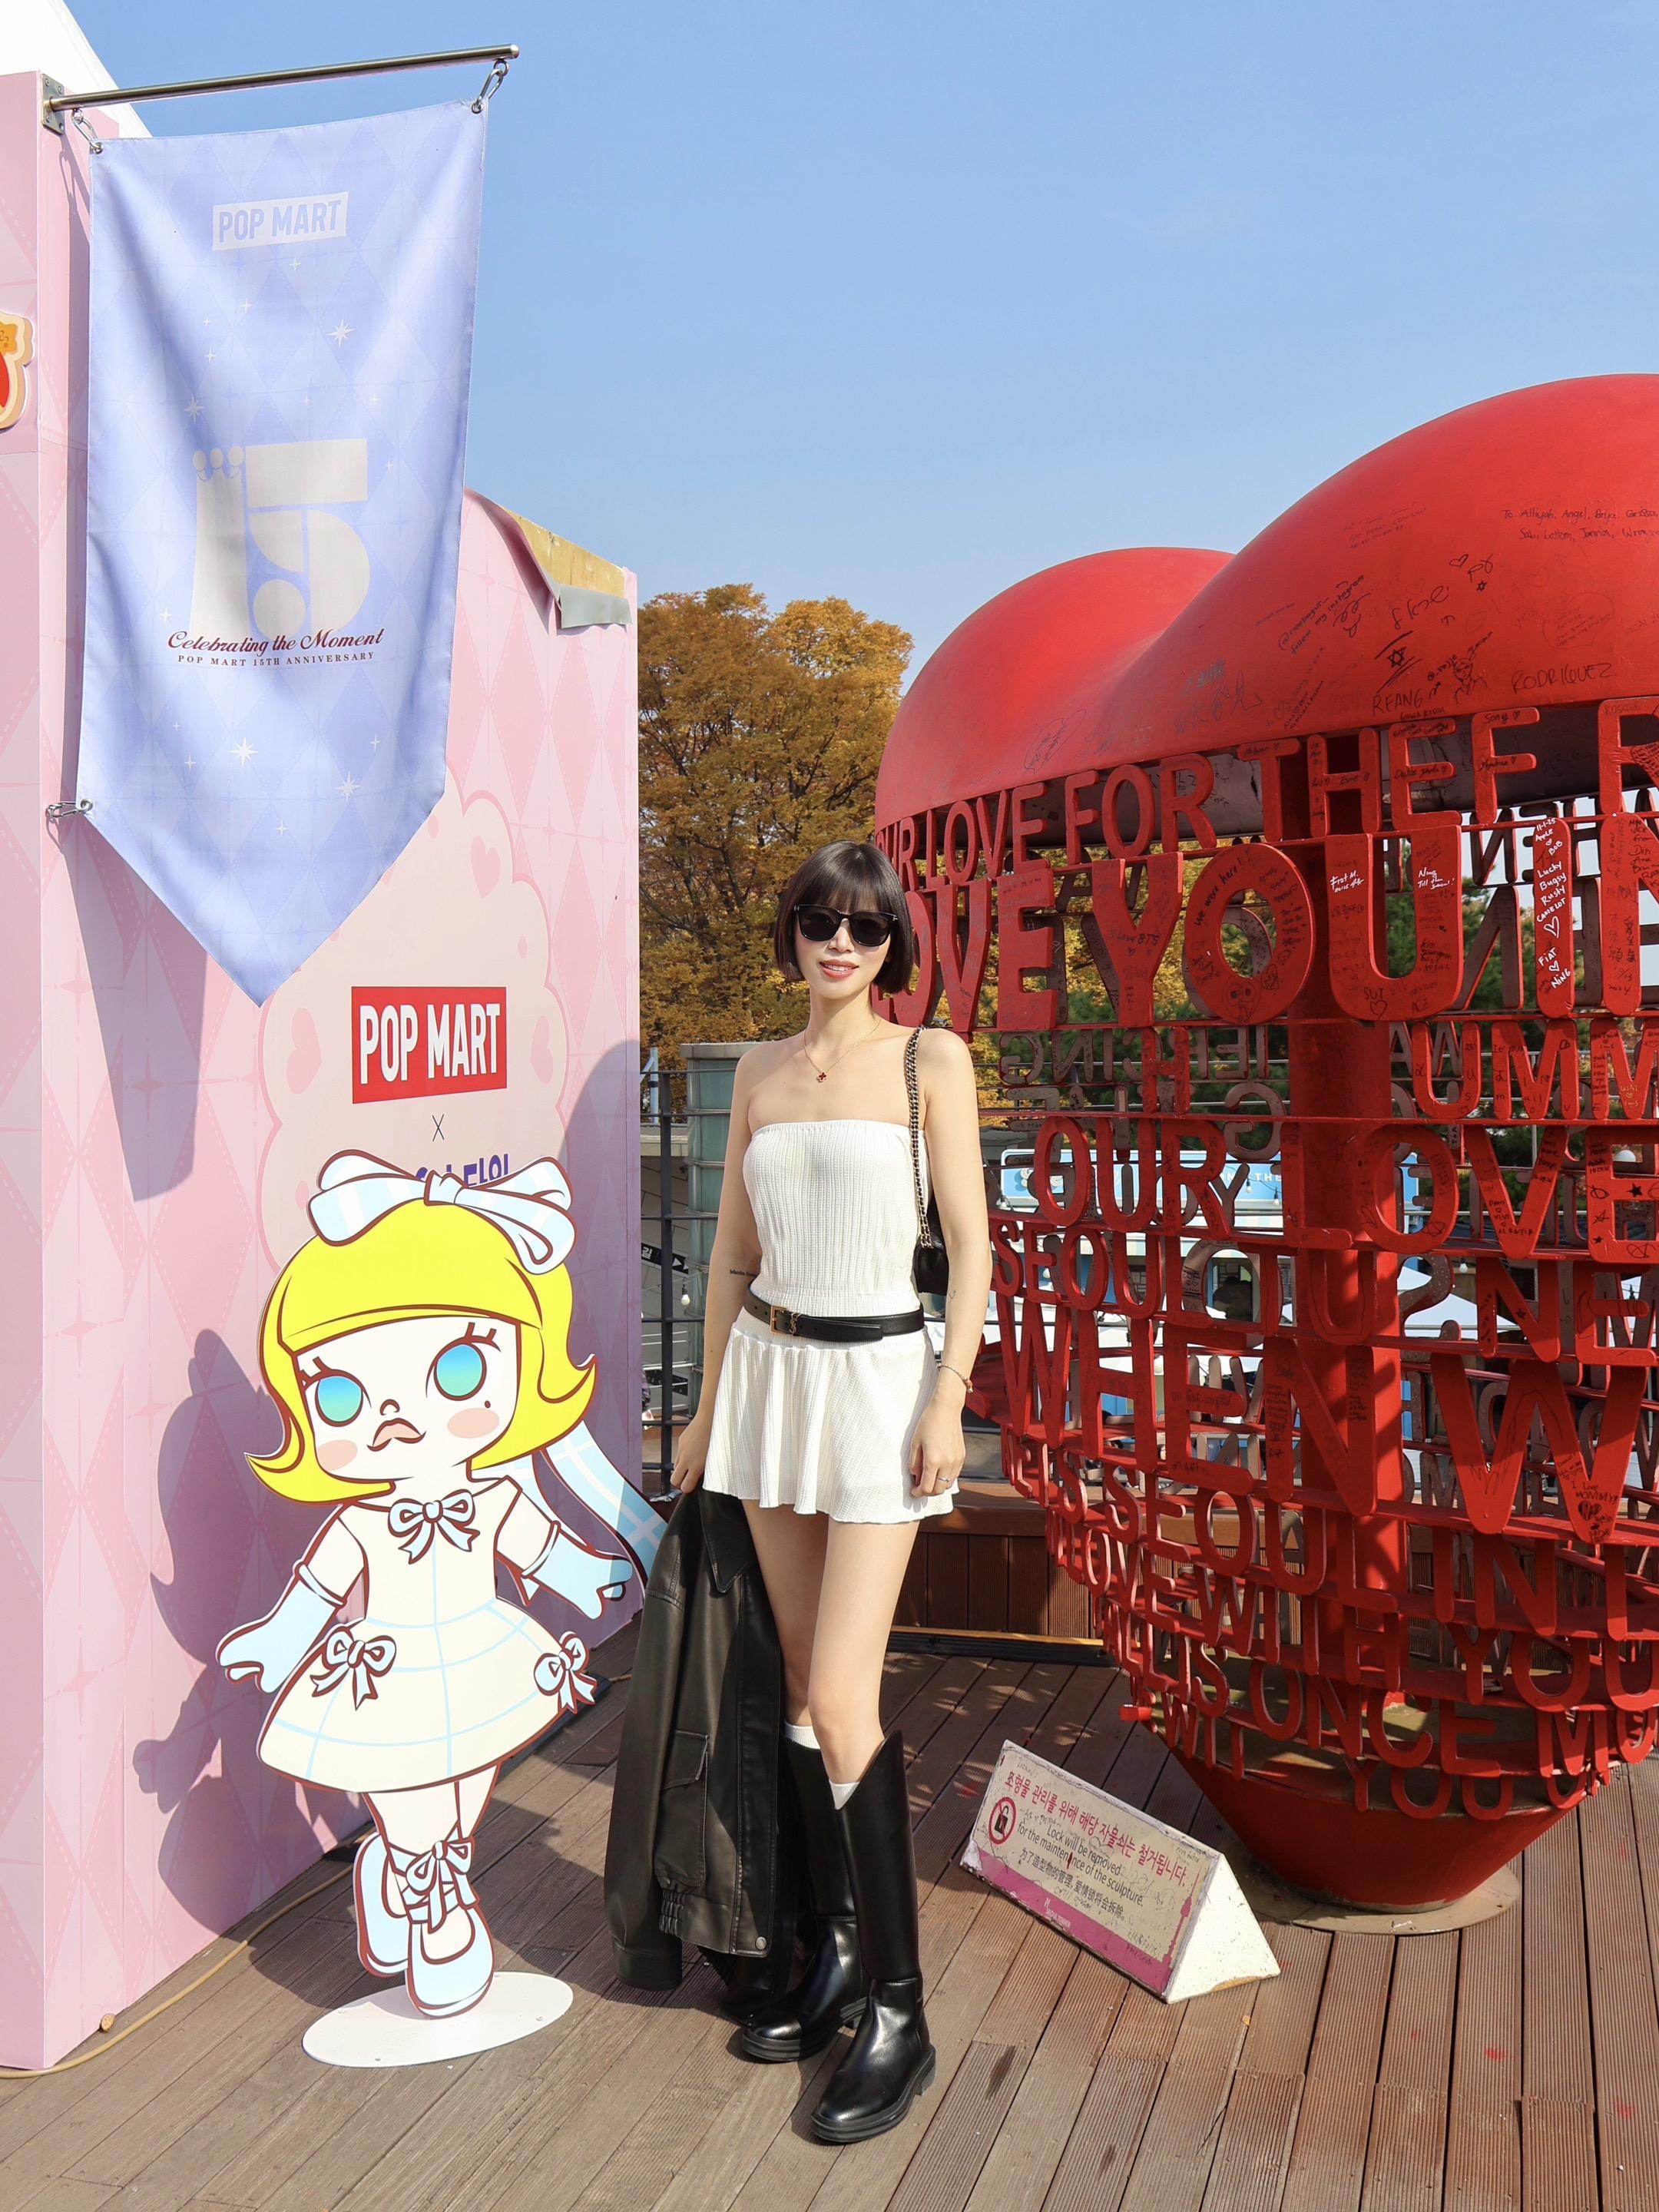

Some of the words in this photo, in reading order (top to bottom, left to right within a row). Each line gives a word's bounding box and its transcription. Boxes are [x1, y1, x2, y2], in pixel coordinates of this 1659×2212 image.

[219, 208, 265, 243] POP
[271, 200, 342, 237] MART
[168, 630, 269, 657] Celebrating
[272, 634, 296, 652] the
[300, 628, 385, 651] Moment
[178, 655, 204, 664] POP
[210, 657, 247, 667] MART
[253, 658, 280, 667] 15TH
[286, 651, 375, 665] ANNIVERSARY
[926, 782, 1049, 889] LOVE
[1065, 753, 1217, 866] FOR
[1538, 860, 1563, 878] Lucky
[1539, 873, 1568, 892] Bugsy
[1540, 885, 1566, 906] Rusty
[872, 867, 1057, 1031] OVE
[1092, 825, 1462, 1025] YOU
[359, 1004, 419, 1085] POP
[426, 1003, 501, 1079] MART
[1034, 1116, 1229, 1240] OUR
[1282, 1121, 1659, 1264] LOVE
[992, 1217, 1214, 1329] SEOUL
[998, 1296, 1376, 1516] WHEN
[1104, 1462, 1399, 1613] SEOUL
[1250, 1659, 1502, 1778] ONCE
[1005, 1771, 1031, 1798] 조형물
[1032, 1785, 1058, 1813] 관리를
[1059, 1800, 1079, 1825] 위해
[1079, 1812, 1099, 1836] 해당
[1099, 1823, 1136, 1858] 자물쇠는
[1138, 1843, 1187, 1887] 철거됩니다.
[1017, 1821, 1029, 1834] for
[1028, 1829, 1041, 1844] the
[1040, 1838, 1087, 1871] maintennce
[1085, 1861, 1095, 1875] of
[1095, 1869, 1108, 1884] the
[1106, 1877, 1144, 1907] sculpture.
[1047, 1824, 1064, 1842] Lock
[1065, 1834, 1079, 1853] will
[1078, 1842, 1089, 1857] be
[1088, 1850, 1122, 1876] removed
